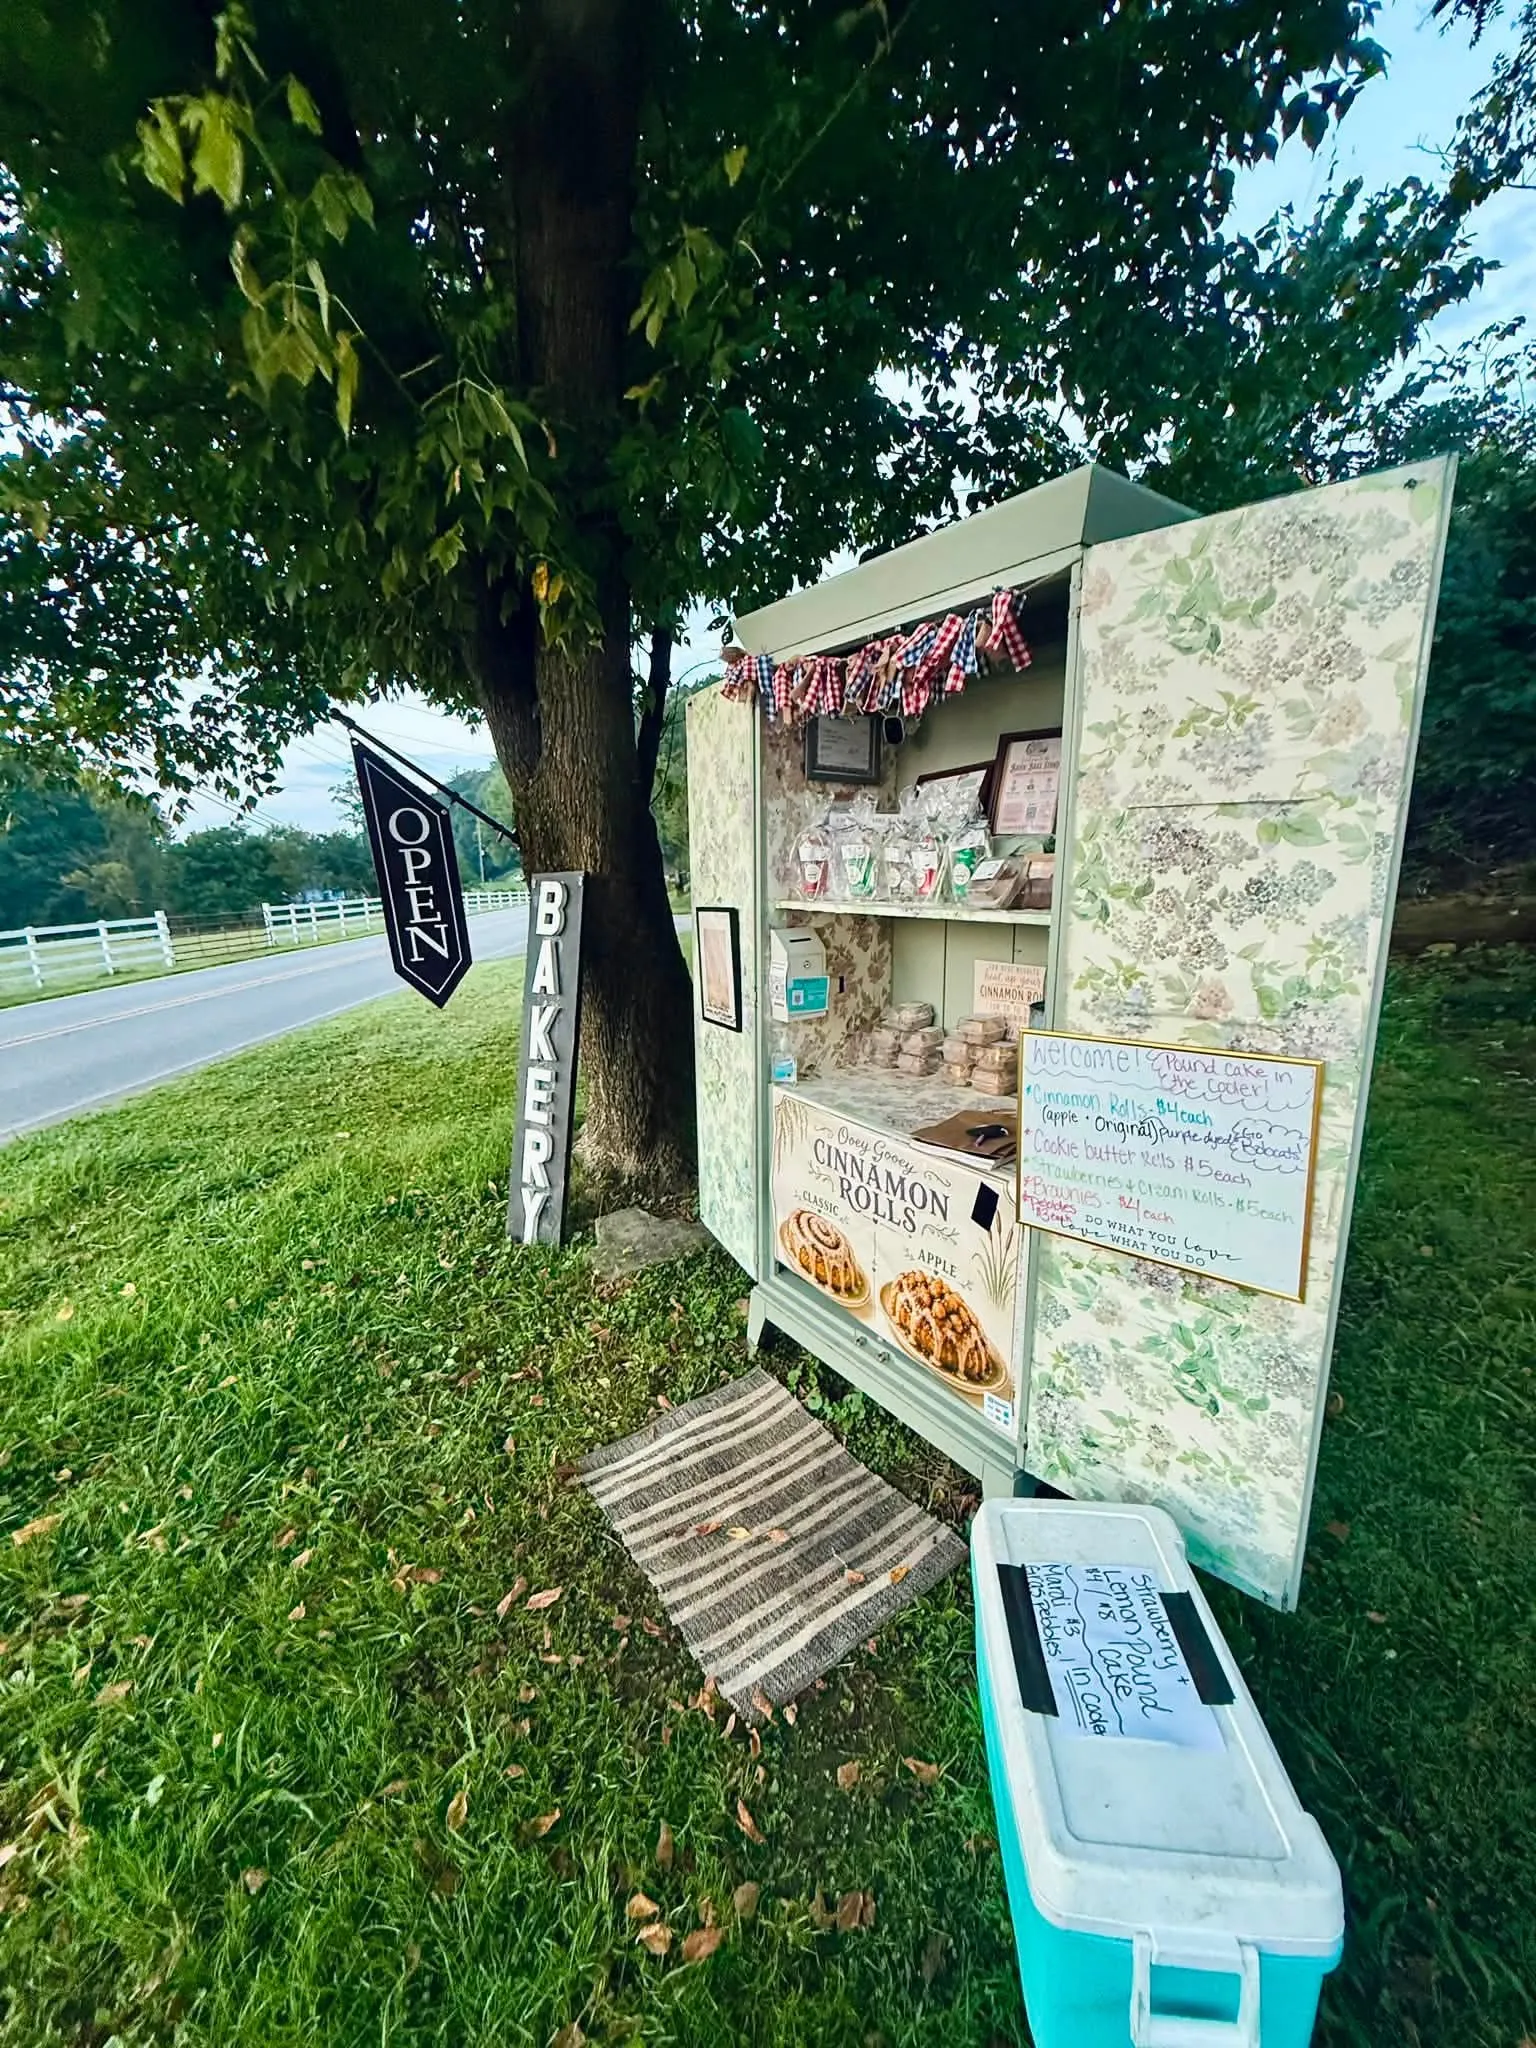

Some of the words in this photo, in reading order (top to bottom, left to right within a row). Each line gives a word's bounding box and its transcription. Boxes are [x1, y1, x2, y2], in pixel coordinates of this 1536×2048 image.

[388, 807, 449, 963] OPEN
[980, 984, 1024, 1001] CINNAMON
[522, 880, 568, 1245] BAKERY
[1034, 1040, 1141, 1073] Welcome!
[1166, 1055, 1217, 1075] Pound
[1172, 1074, 1197, 1090] the
[1033, 1084, 1101, 1112] Cinnamon
[1181, 1109, 1213, 1127] each
[838, 1126, 871, 1156] Ooey
[872, 1140, 918, 1175] Gooey
[1242, 1128, 1263, 1140] Go
[814, 1138, 950, 1222] CINNAMON
[1084, 1139, 1137, 1165] butter
[1214, 1170, 1252, 1188] each
[802, 1190, 839, 1216] CLASSIC
[839, 1175, 916, 1233] ROLLS
[1033, 1176, 1102, 1209] Brownies
[1143, 1209, 1175, 1225] each
[1260, 1208, 1295, 1225] each
[1085, 1214, 1103, 1226] DO
[1107, 1220, 1145, 1237] WHAT
[1149, 1230, 1177, 1245] YOU
[1110, 1234, 1148, 1251] WHAT
[1152, 1245, 1180, 1260] YOU
[1185, 1254, 1206, 1267] DO
[918, 1249, 957, 1278] APPLE
[1043, 1564, 1071, 1607] Mardi
[1103, 1570, 1142, 1635] Lemon
[1132, 1574, 1179, 1669] Strawberry
[1107, 1637, 1173, 1719] Pound
